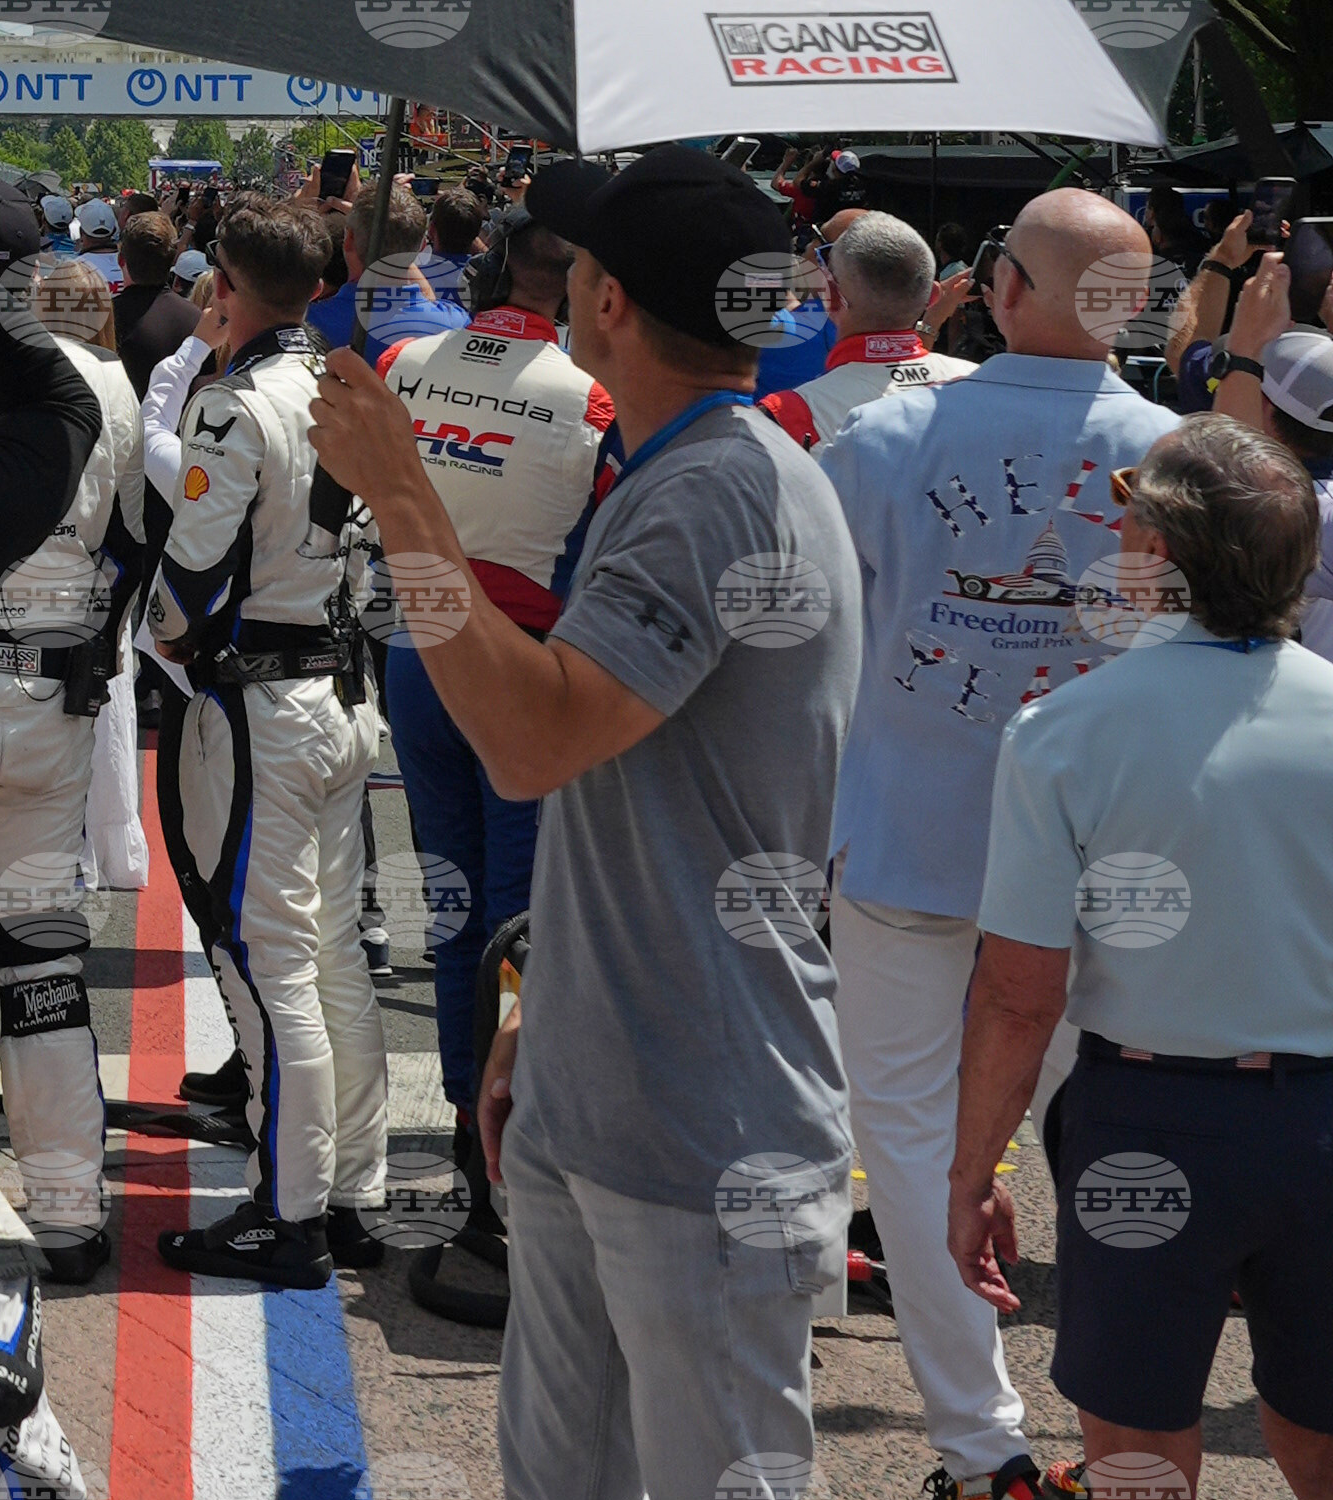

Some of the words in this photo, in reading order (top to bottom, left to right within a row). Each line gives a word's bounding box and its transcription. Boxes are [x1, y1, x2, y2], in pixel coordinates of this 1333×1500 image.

[762, 22, 937, 53] GANASSI
[730, 55, 945, 76] RACING
[16, 74, 93, 101] NTT
[174, 74, 253, 102] NTT
[465, 338, 507, 357] OMP
[890, 367, 931, 382] OMP
[427, 383, 554, 424] Honda
[412, 418, 516, 467] HRC
[449, 460, 503, 477] RACING
[930, 602, 1060, 635] Freedom
[992, 636, 1039, 650] Grand
[1043, 636, 1074, 649] Prix
[24, 979, 82, 1018] Mechanix
